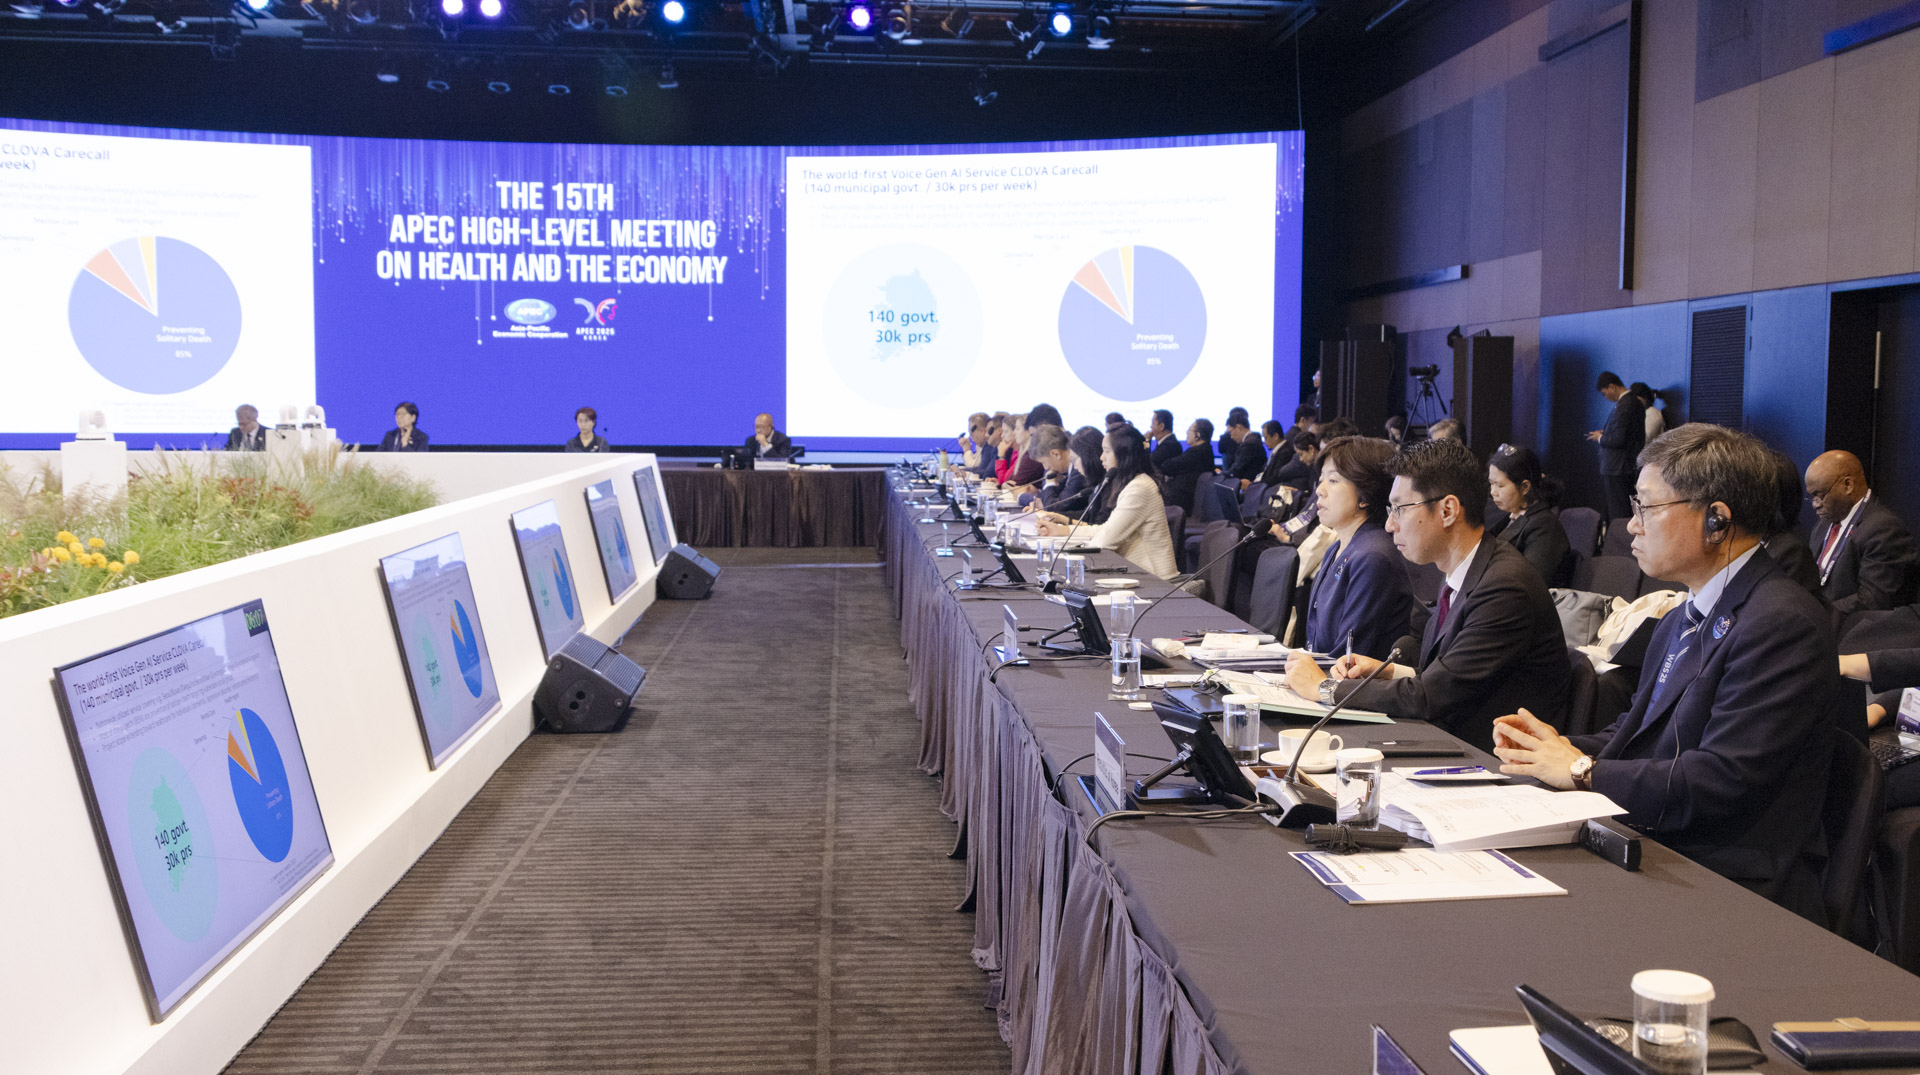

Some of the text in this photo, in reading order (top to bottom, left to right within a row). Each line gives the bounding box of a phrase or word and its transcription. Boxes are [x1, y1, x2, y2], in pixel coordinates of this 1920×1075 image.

[2, 143, 110, 161] CLOVA Carecall
[803, 164, 1099, 180] The world-first Voice Gen AI Service CLOVA Carecall
[496, 181, 614, 212] THE 15TH
[804, 182, 831, 195] (140
[834, 182, 890, 196] municipal
[935, 181, 955, 192] 30k
[959, 182, 978, 194] prs
[981, 181, 999, 194] per
[1003, 179, 1038, 192] week)
[390, 214, 717, 249] APEC HIGH-LEVEL MEETING
[376, 250, 728, 285] ON HEALTH AND THE ECONOMY
[517, 307, 544, 316] APEC
[868, 309, 939, 328] 140 govt.
[156, 334, 212, 345] Solitary Death
[162, 325, 206, 336] Preventing
[576, 327, 595, 335] APEC
[875, 328, 932, 348] 30k prs
[1136, 333, 1174, 342] Preventing
[175, 350, 192, 359] 85%
[1131, 342, 1179, 351] Solitary Death
[1146, 357, 1162, 366] 85%
[73, 681, 87, 696] The
[87, 671, 119, 692] world-first
[118, 664, 136, 679] Voice
[134, 660, 147, 673] Gen
[152, 650, 172, 666] Service
[171, 644, 189, 658] CLOVA
[1659, 654, 1675, 683] WBS25
[80, 694, 96, 715] (140
[95, 683, 124, 704] municipal
[143, 672, 155, 687] 30k
[154, 669, 165, 685] prs
[164, 666, 174, 682] per
[173, 658, 190, 675] week)
[155, 820, 190, 849] 140 govt.
[165, 844, 193, 871] 30k prs
